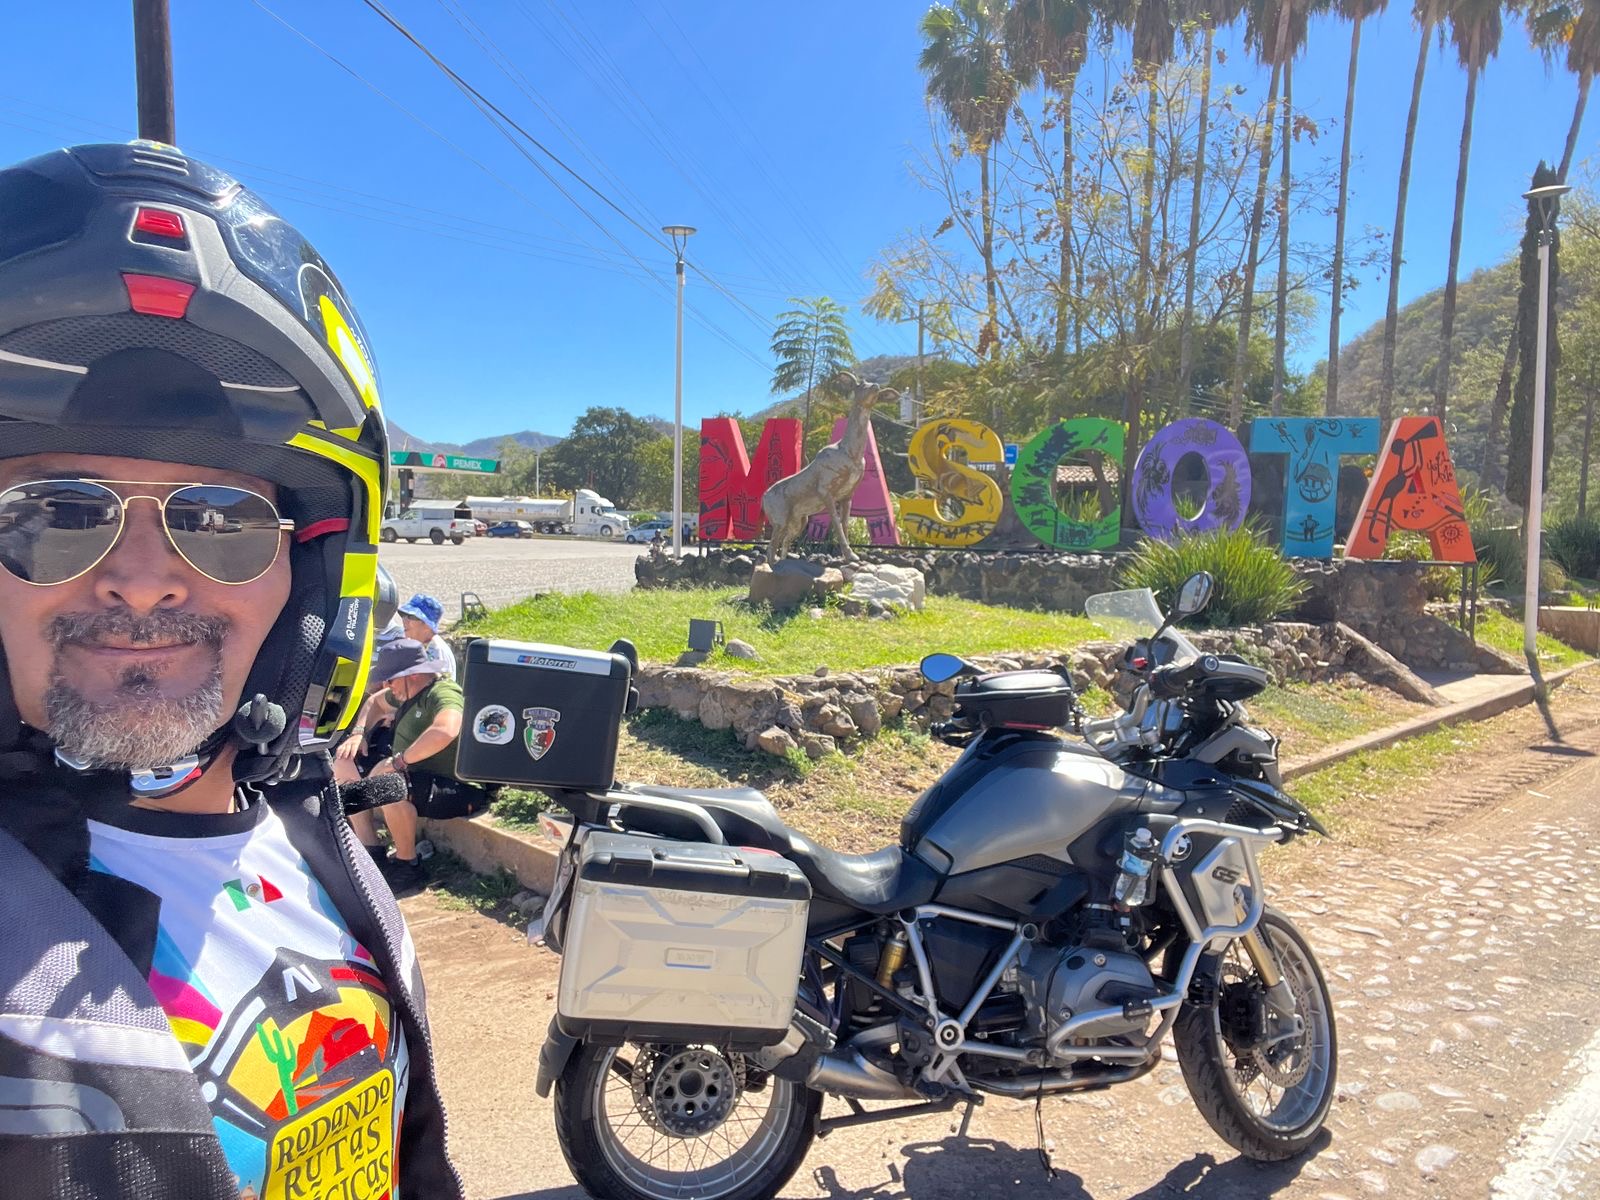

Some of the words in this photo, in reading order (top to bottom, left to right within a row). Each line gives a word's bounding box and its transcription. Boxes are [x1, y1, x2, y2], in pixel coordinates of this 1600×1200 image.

[453, 459, 482, 470] PEMEX
[698, 416, 1477, 563] MASCOTA
[530, 656, 577, 670] Motorrad
[1212, 866, 1241, 885] GS
[282, 964, 322, 1002] N
